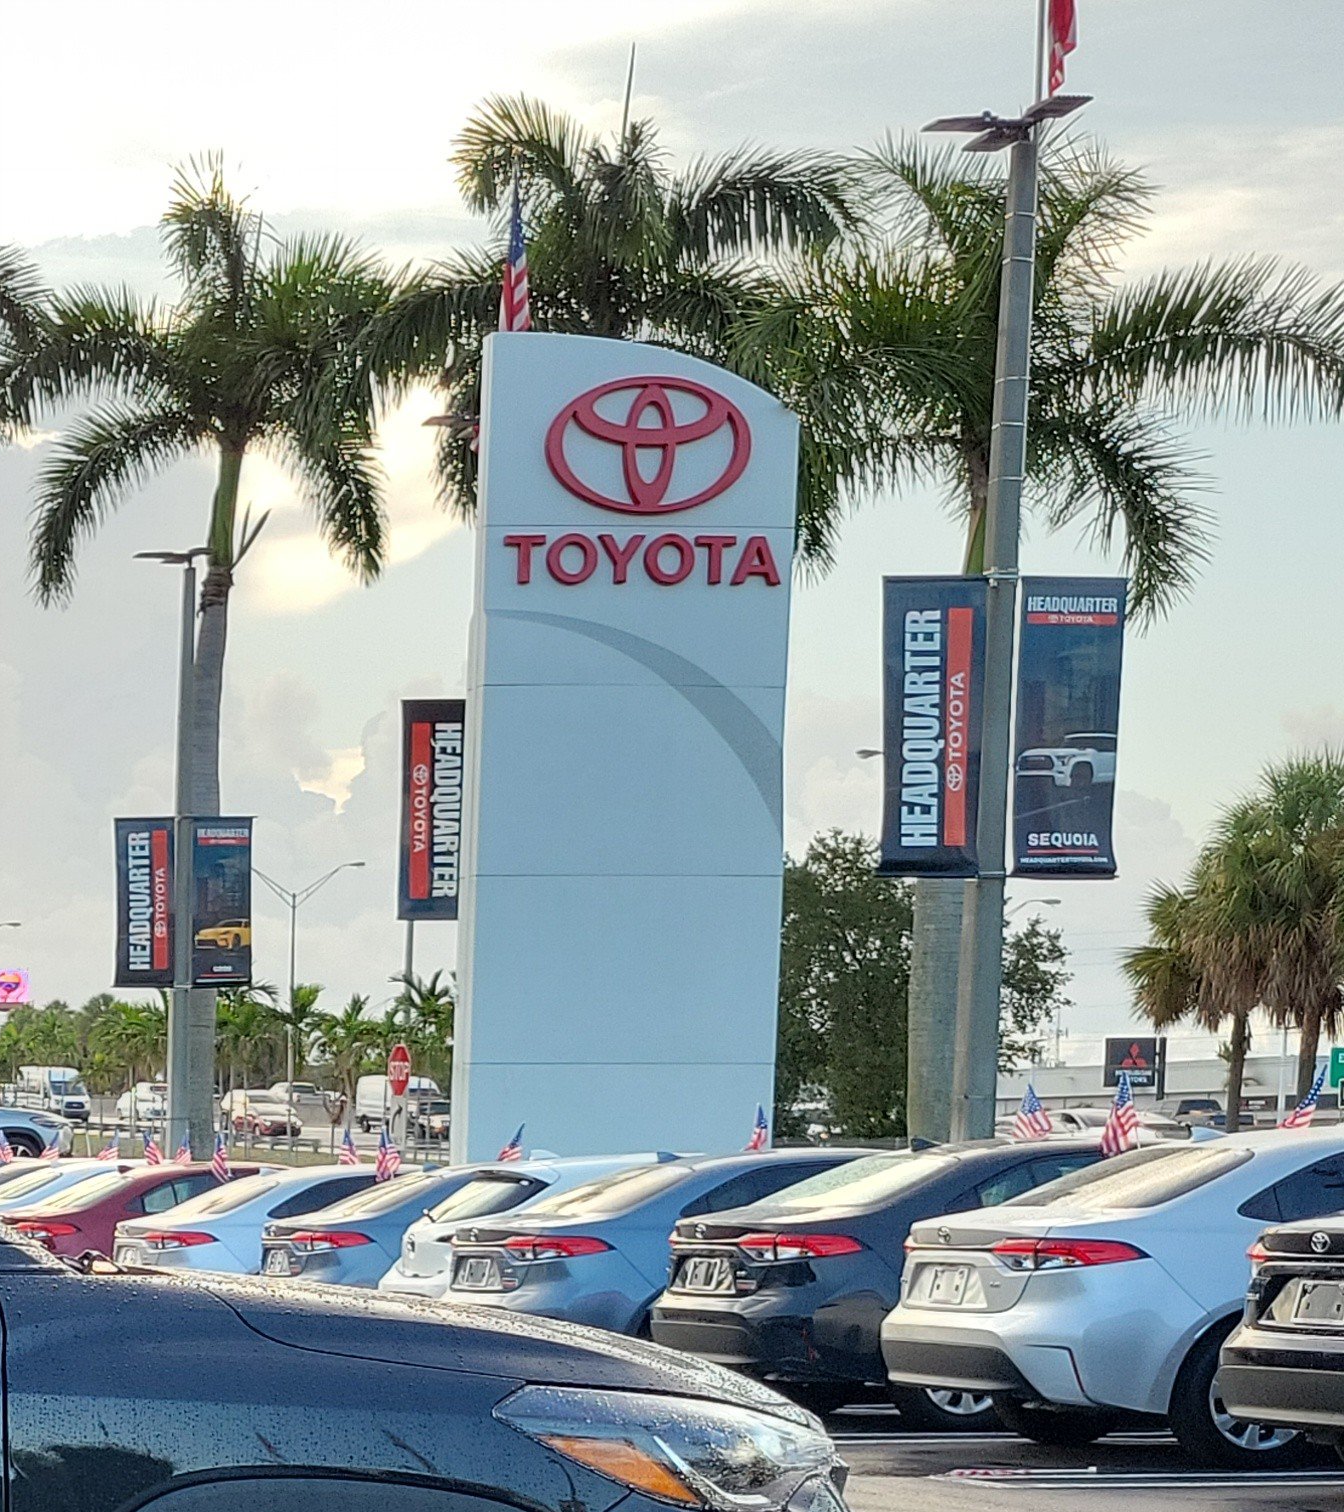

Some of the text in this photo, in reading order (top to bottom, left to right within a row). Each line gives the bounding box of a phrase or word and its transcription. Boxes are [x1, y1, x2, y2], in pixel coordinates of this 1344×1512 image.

[503, 533, 782, 586] TOYOTA
[1027, 597, 1117, 614] HEADQUARTER
[900, 609, 946, 847] HEADQUARTER
[948, 671, 966, 762] TOYOTA
[413, 787, 426, 853] TOYOTA
[430, 722, 463, 898] HEADQUARTER
[1027, 833, 1099, 848] SEQUOIA
[127, 831, 154, 971] HEADQUARTER
[155, 868, 166, 921] TOYOTA
[388, 1061, 410, 1081] STOP
